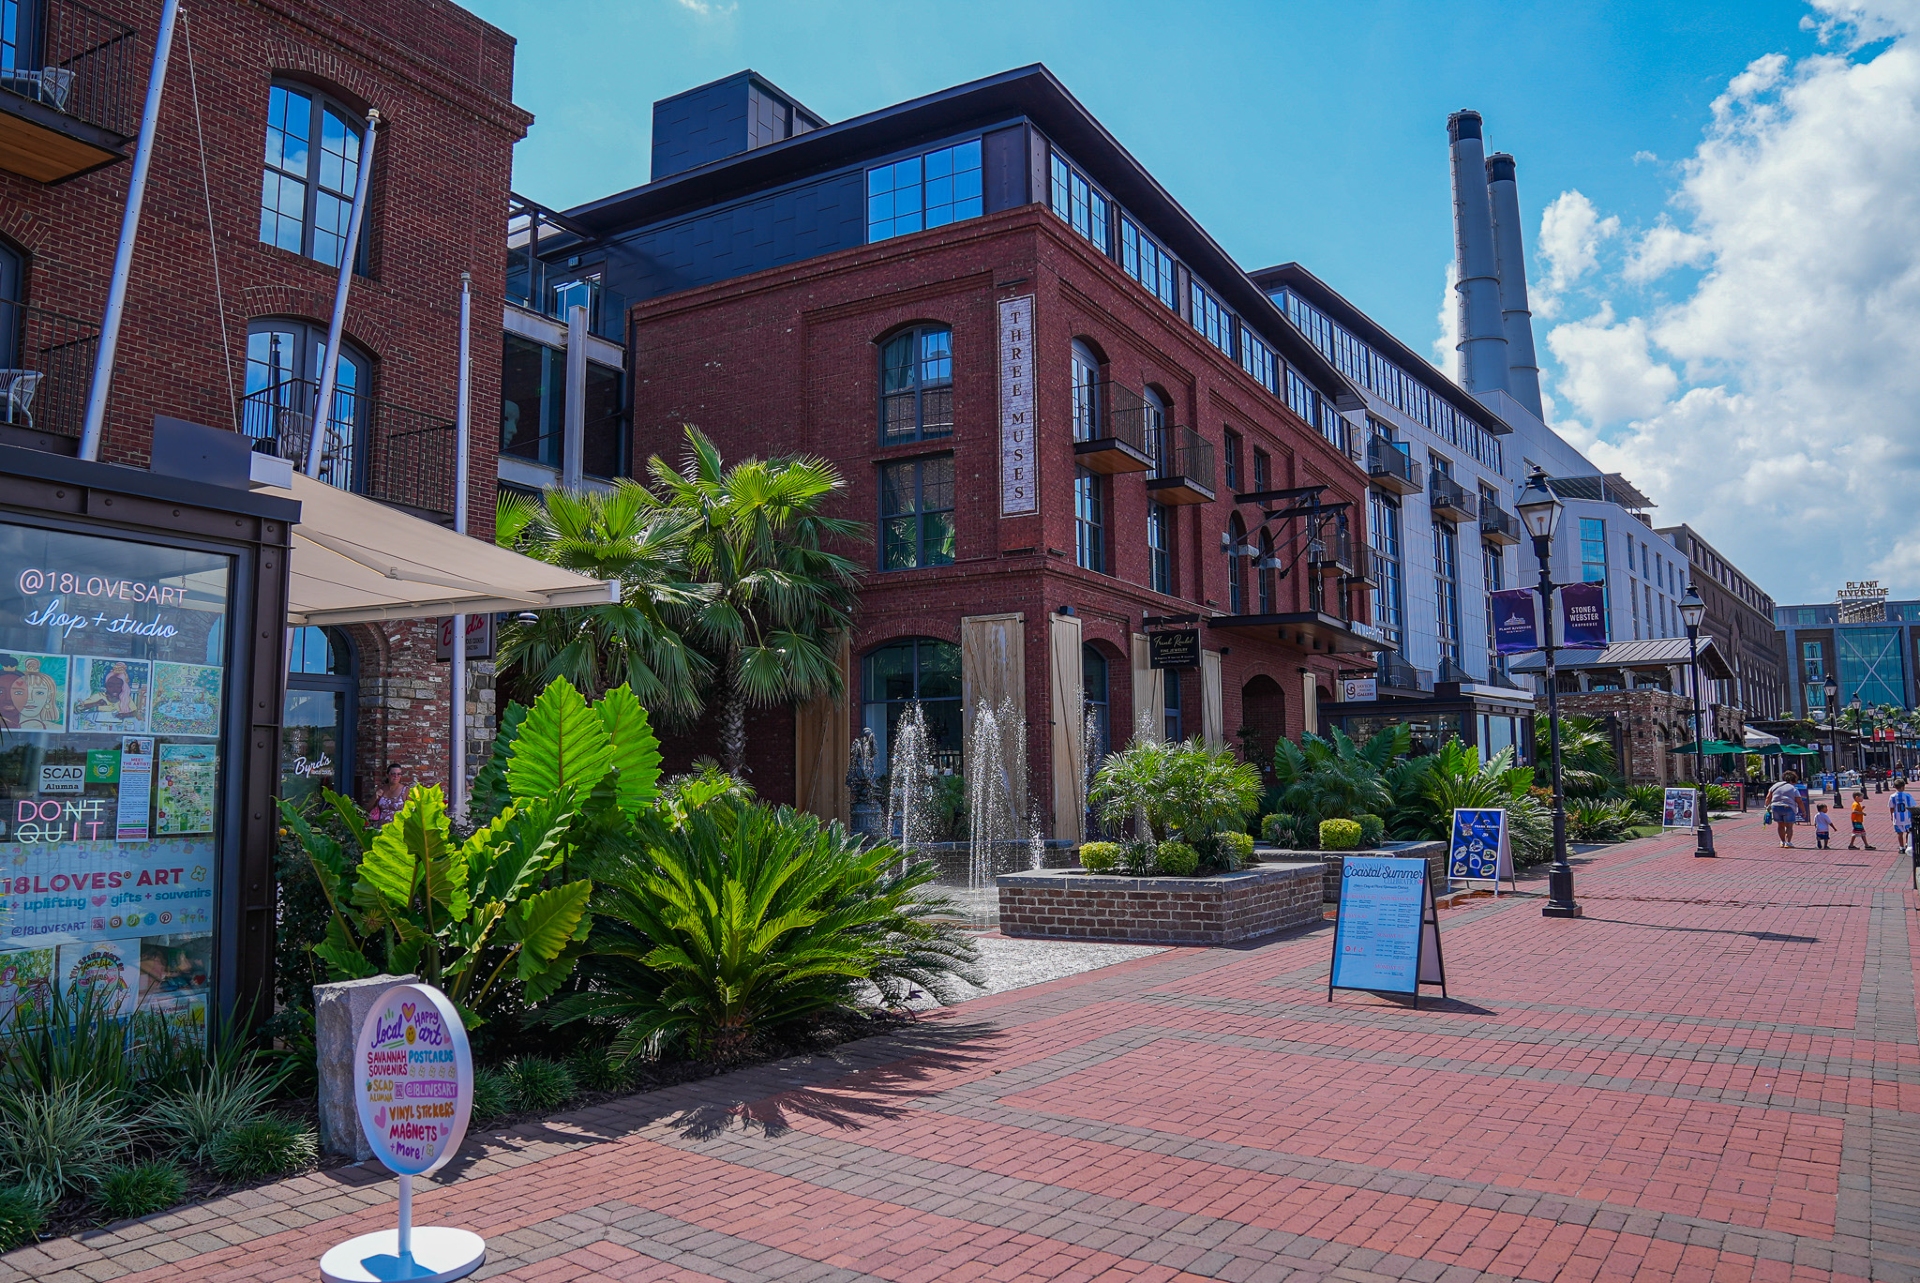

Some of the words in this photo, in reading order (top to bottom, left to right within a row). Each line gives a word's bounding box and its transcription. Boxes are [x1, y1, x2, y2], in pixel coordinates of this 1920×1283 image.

[1010, 311, 1023, 398] THREE
[1011, 410, 1025, 500] MUSES
[18, 567, 189, 607] @18LOVESART
[1837, 587, 1890, 598] RIVERSIDE
[1846, 580, 1880, 590] PLANT
[24, 599, 89, 638] shop
[106, 612, 179, 639] studio
[1569, 613, 1600, 622] WEBSTER
[42, 767, 84, 780] SCAD
[293, 752, 332, 779] Byrd's
[44, 783, 80, 791] Alumna
[18, 799, 107, 822] DON'T
[1897, 802, 1906, 813] 10
[14, 820, 105, 845] QUIT
[136, 867, 185, 888] ART
[1342, 864, 1383, 879] Coastal
[1381, 865, 1424, 880] Summer
[24, 894, 87, 913] uplifting
[111, 891, 142, 907] gifts
[155, 887, 212, 901] souvenirs
[11, 921, 87, 937] @18LOVESART
[414, 1010, 439, 1029] HAPPY
[370, 1013, 405, 1049] local
[418, 1023, 443, 1047] art
[367, 1050, 407, 1065] SAVANNAH
[408, 1049, 454, 1064] POSTCARDS
[369, 1092, 394, 1103] ALUMNA
[373, 1079, 394, 1091] SCAD
[405, 1082, 458, 1098] @18LOVESART
[389, 1104, 416, 1122] VINYL
